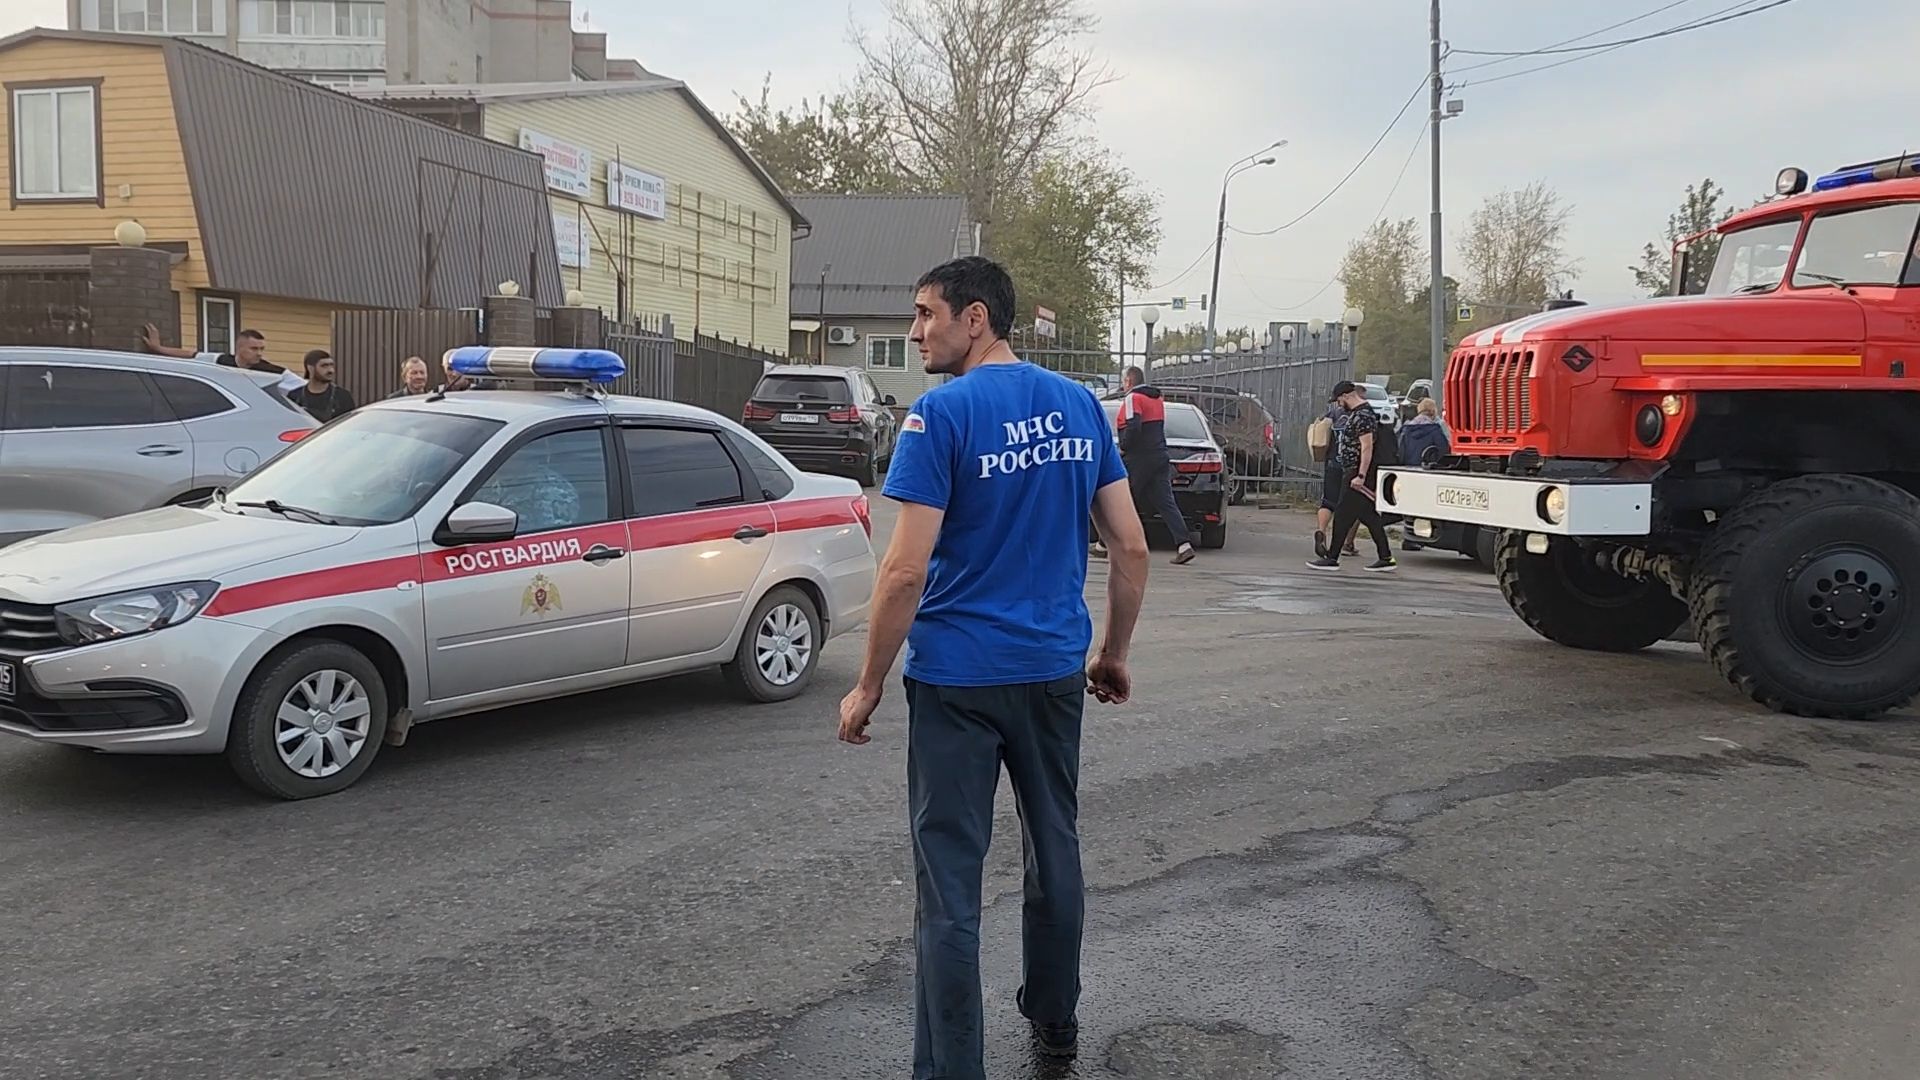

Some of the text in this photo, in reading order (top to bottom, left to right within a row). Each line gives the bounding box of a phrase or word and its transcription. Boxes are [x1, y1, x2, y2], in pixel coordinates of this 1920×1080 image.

[1003, 411, 1064, 446] МЧС
[978, 438, 1094, 478] РОССИИ
[445, 538, 581, 573] РОСГВАРДИЯ
